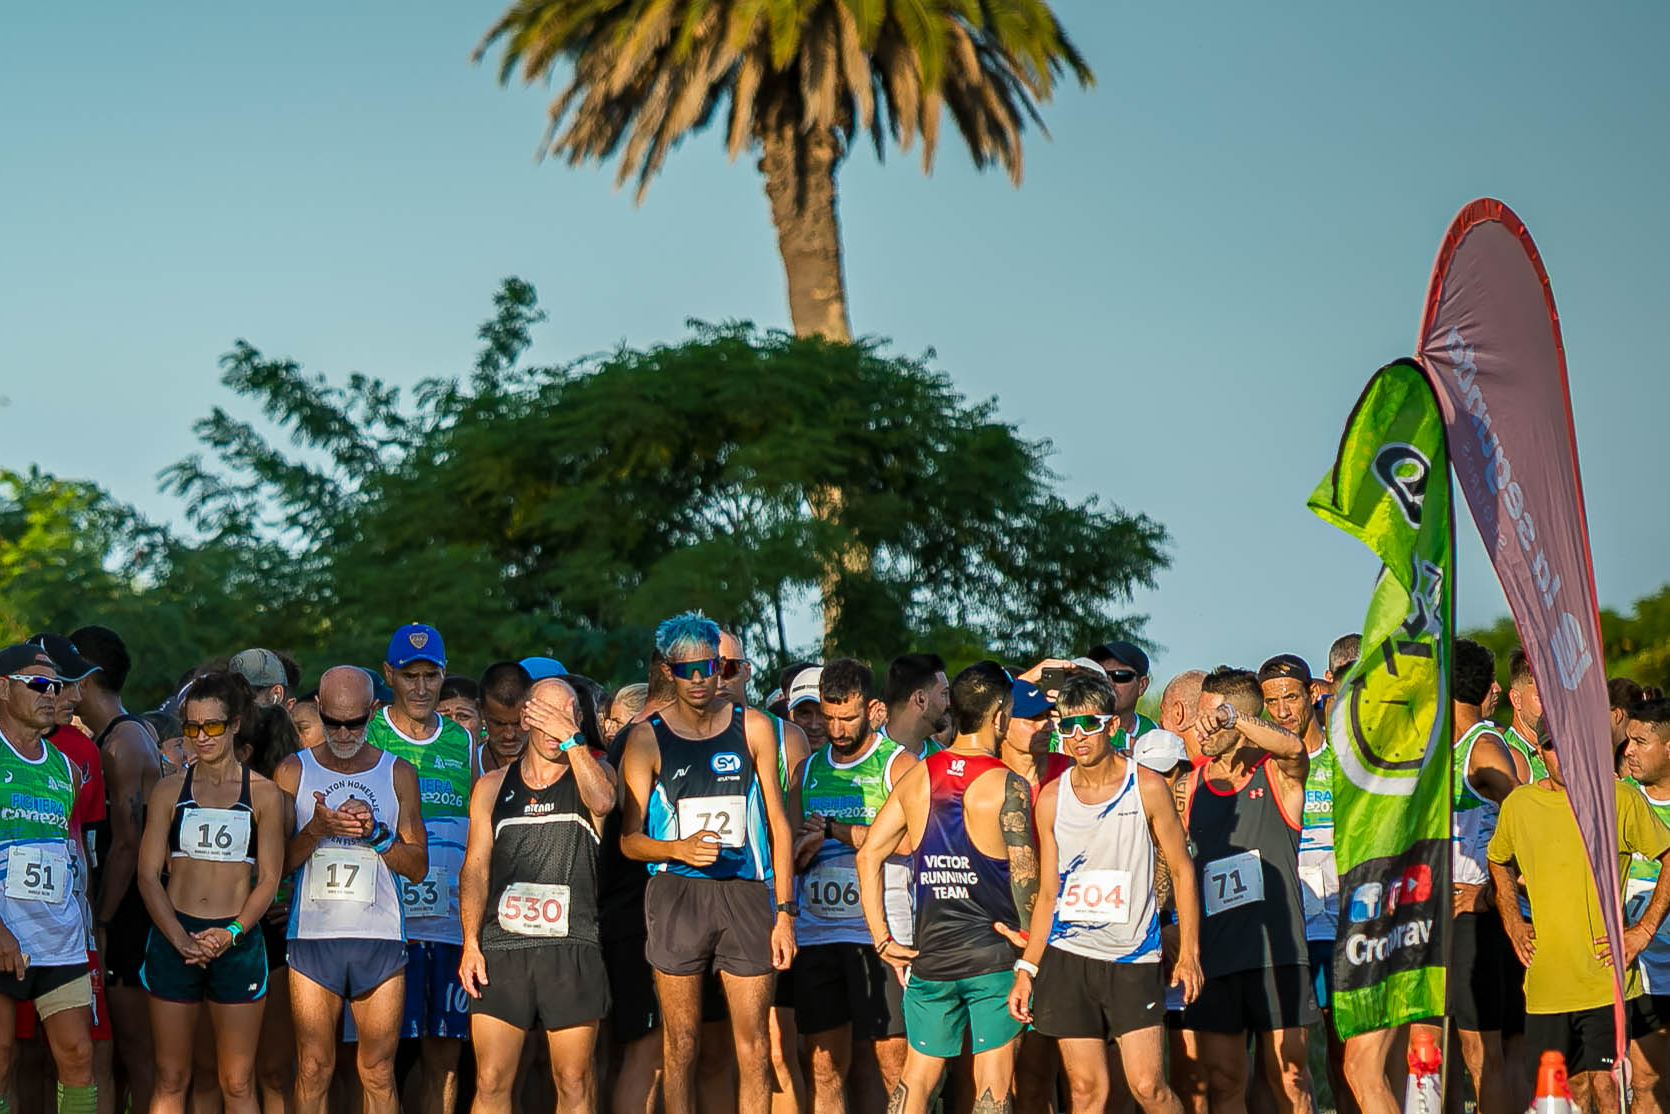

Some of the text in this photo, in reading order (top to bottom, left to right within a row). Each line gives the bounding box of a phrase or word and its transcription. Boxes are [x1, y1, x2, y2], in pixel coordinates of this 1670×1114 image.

[347, 779, 380, 814] HOMENAJE
[197, 823, 233, 849] 16
[696, 811, 733, 835] 72
[923, 854, 971, 870] VICTOR
[23, 862, 55, 891] 51
[326, 863, 360, 889] 17
[920, 870, 979, 885] RUNNING
[1211, 869, 1248, 900] 71
[402, 880, 438, 906] 53
[810, 881, 860, 906] 106
[932, 886, 970, 900] TEAM
[1065, 884, 1126, 910] 504
[504, 895, 563, 924] 530
